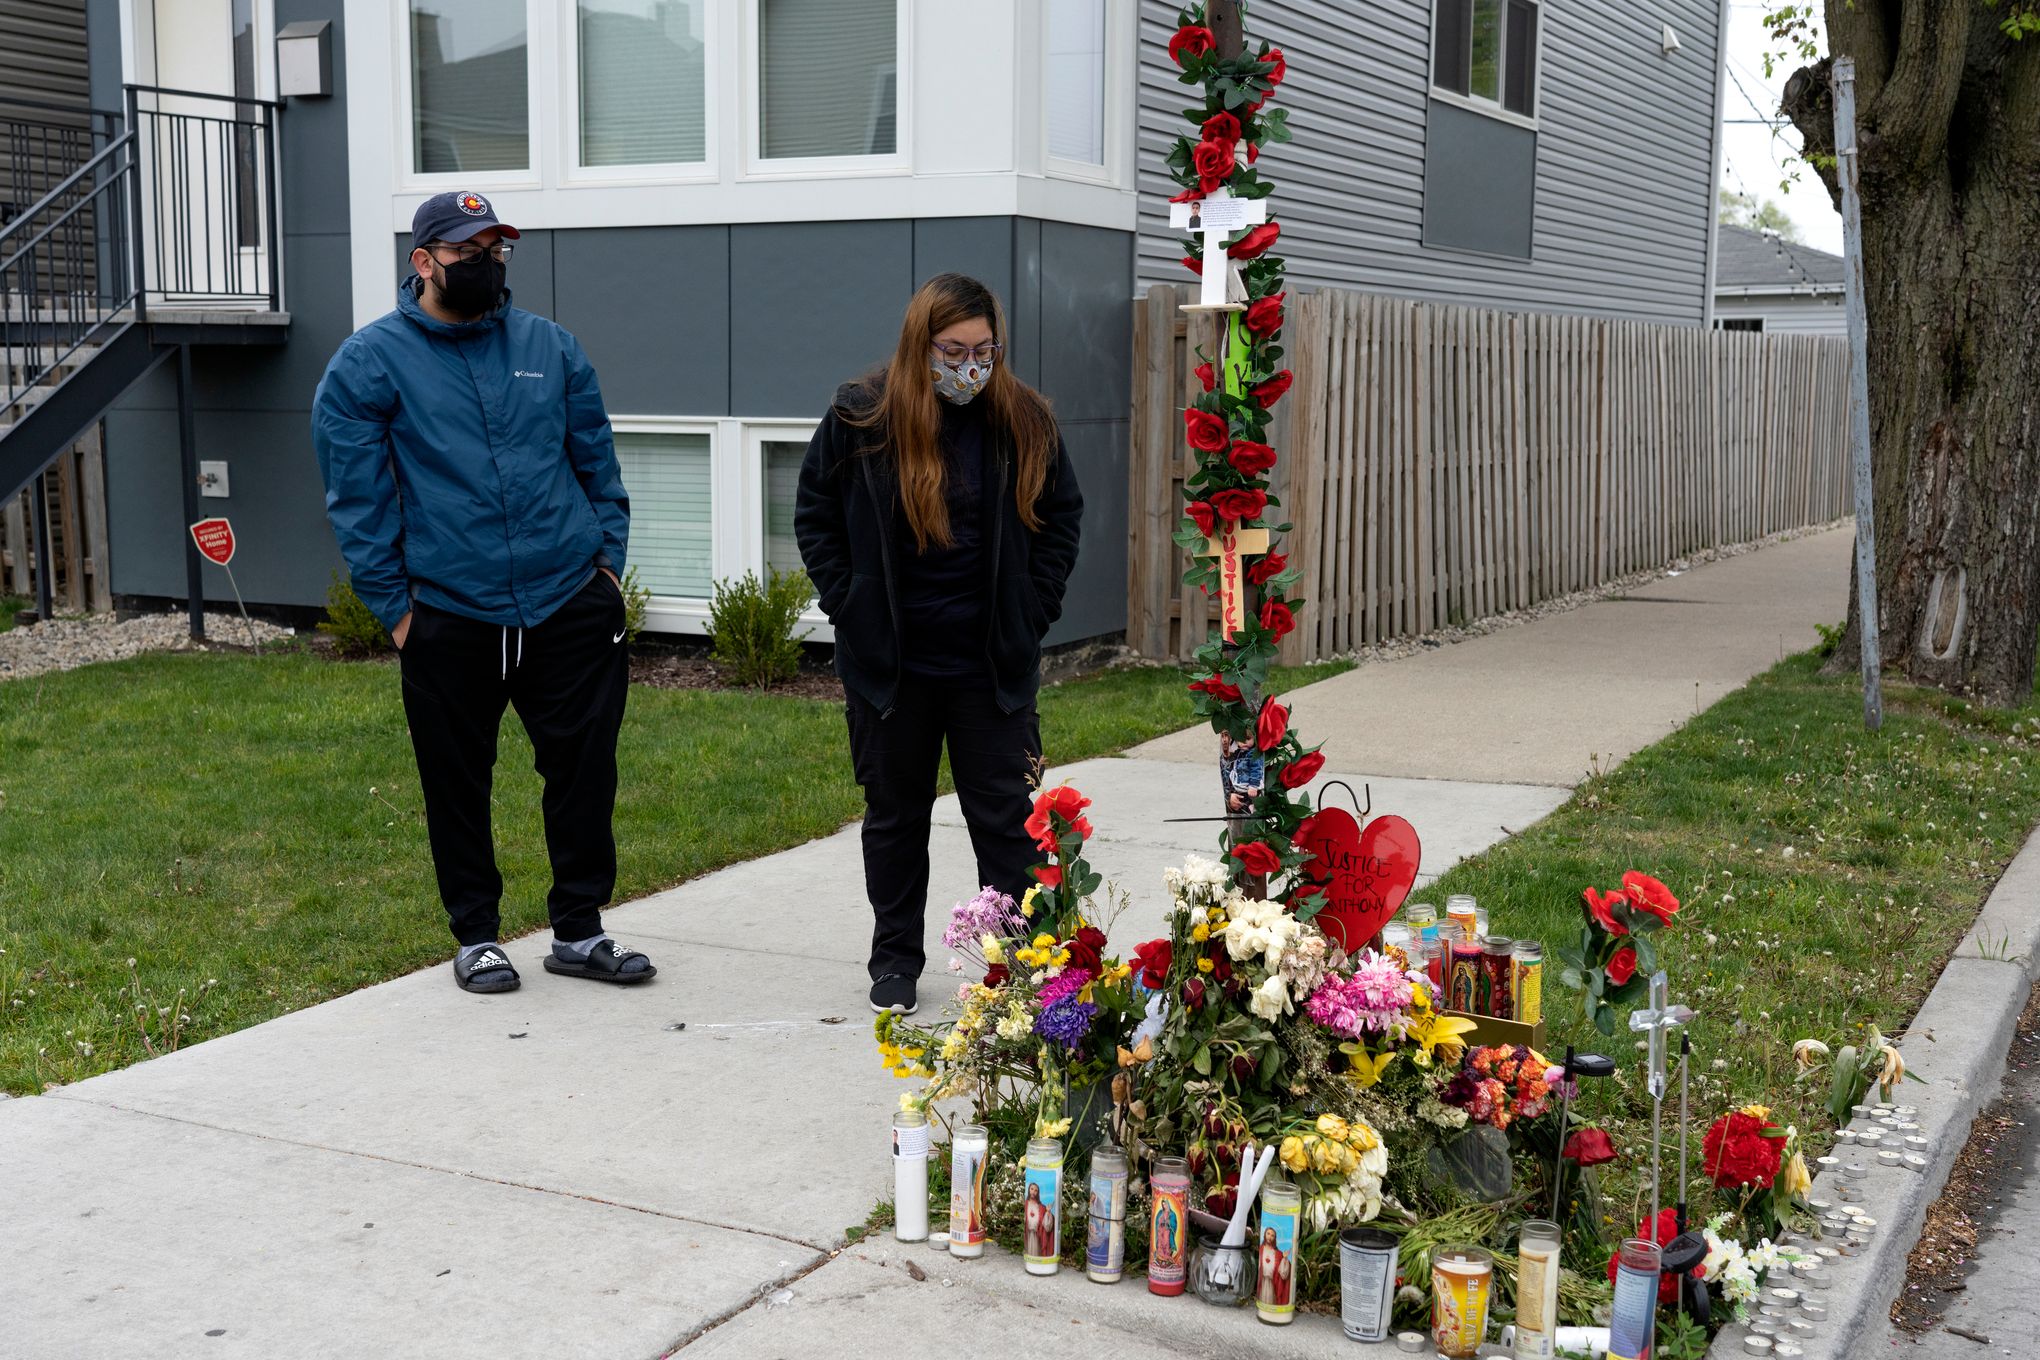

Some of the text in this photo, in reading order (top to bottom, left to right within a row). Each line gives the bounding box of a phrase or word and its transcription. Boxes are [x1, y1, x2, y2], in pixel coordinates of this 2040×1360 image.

[199, 530, 228, 542] XFINITY
[206, 539, 227, 548] Home
[1317, 838, 1392, 877] JUSTICE
[1340, 874, 1377, 896] FOR
[470, 958, 509, 971] adidas
